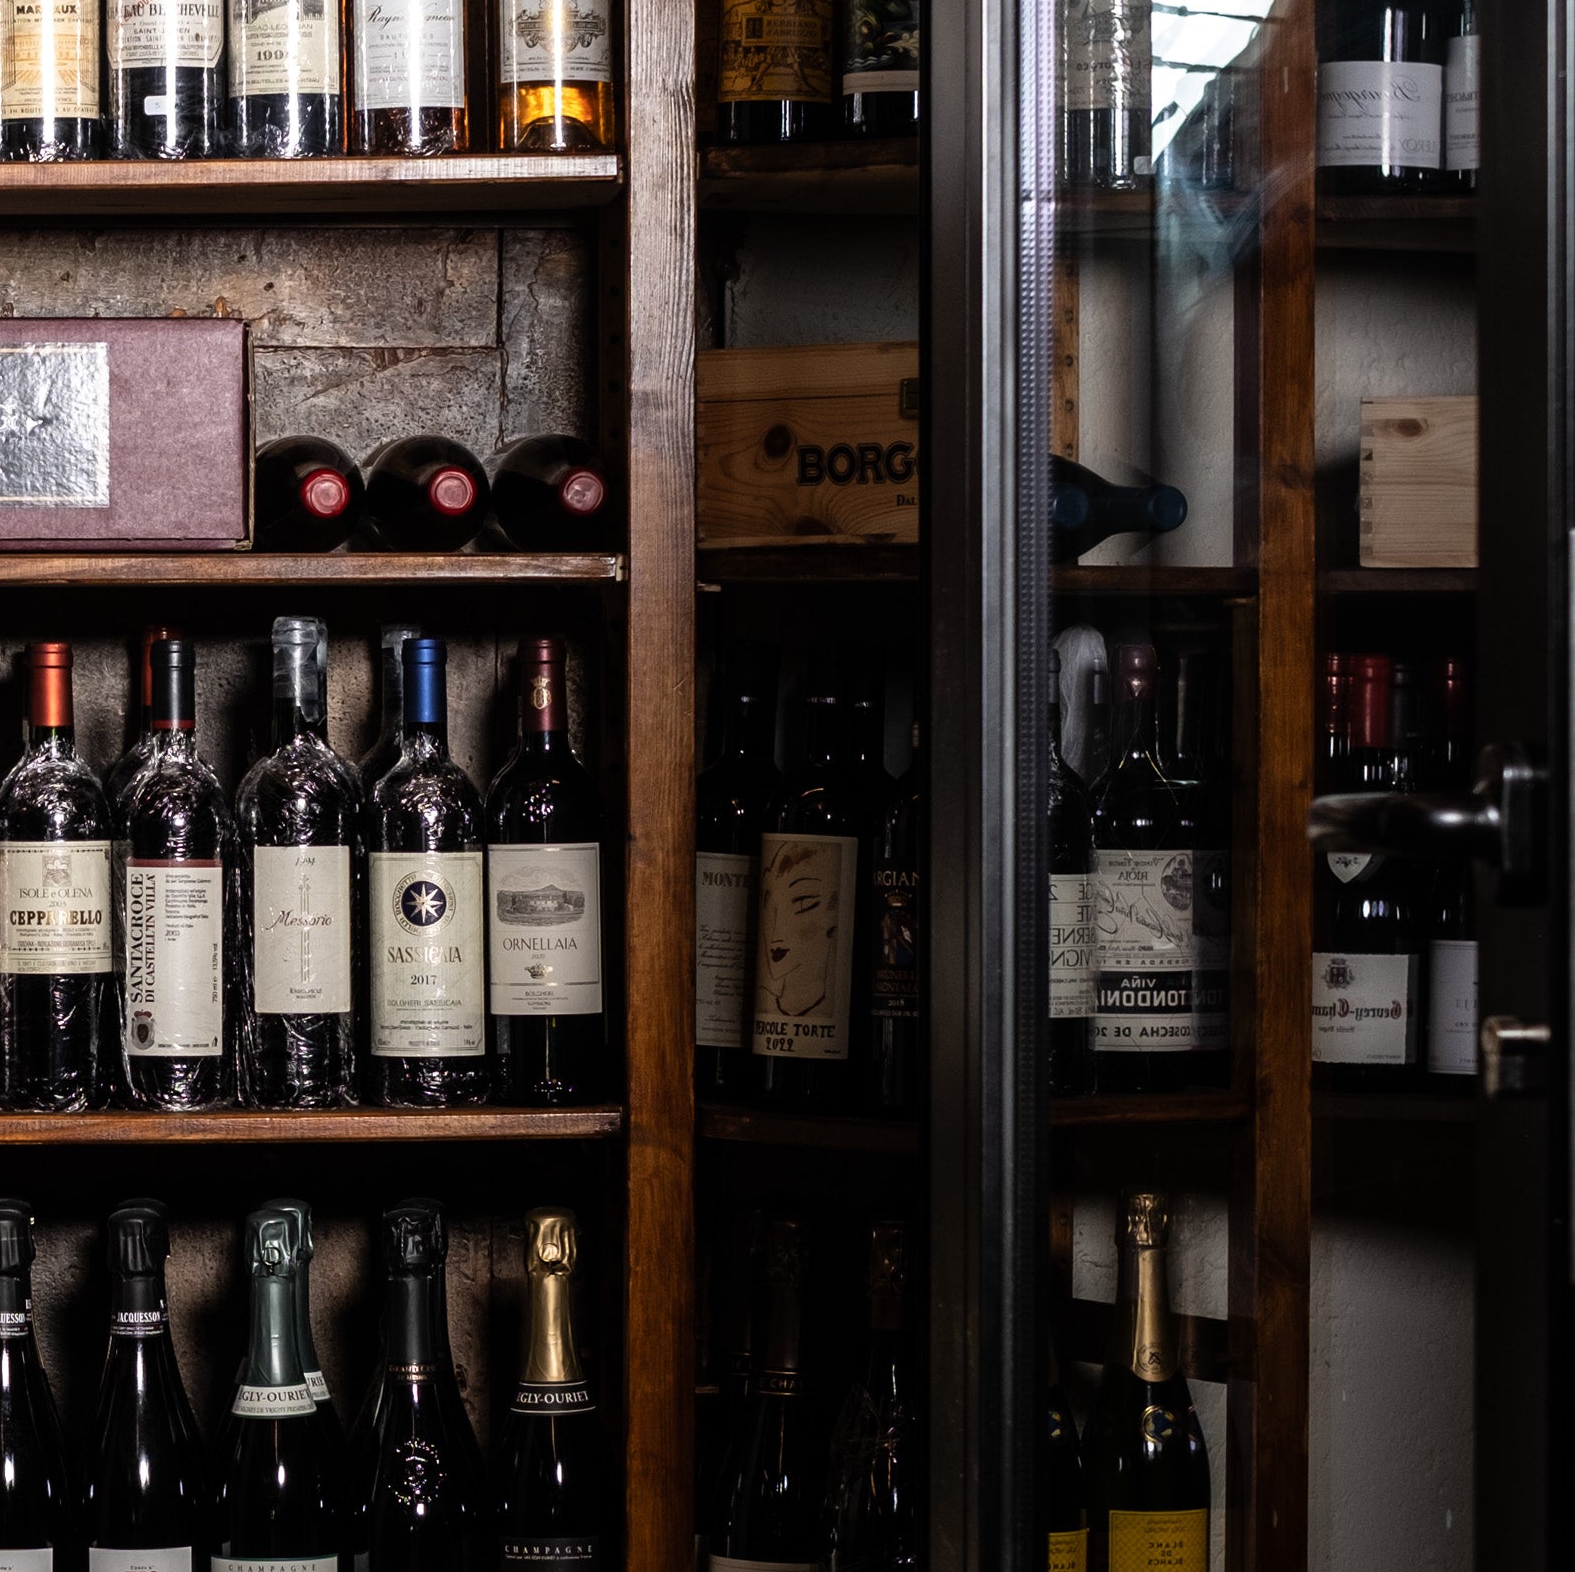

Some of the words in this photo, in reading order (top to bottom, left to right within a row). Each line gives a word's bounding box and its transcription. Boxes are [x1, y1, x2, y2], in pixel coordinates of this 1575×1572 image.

[20, 888, 49, 899] ISOLE
[57, 888, 93, 899] OLENA
[10, 910, 102, 925] CEPPARELLO
[266, 910, 332, 930] Messorio
[131, 873, 143, 1003] SANTACROCE
[503, 937, 578, 951] ORNELLAIA
[387, 946, 462, 964] SASSICAIA
[410, 975, 437, 985] 2017
[145, 994, 155, 1003] DI
[793, 1024, 835, 1038] TORTE
[766, 1038, 795, 1052] 2022
[117, 1311, 161, 1323] JACQUESSON
[505, 1545, 593, 1554] CHAMPAGNE
